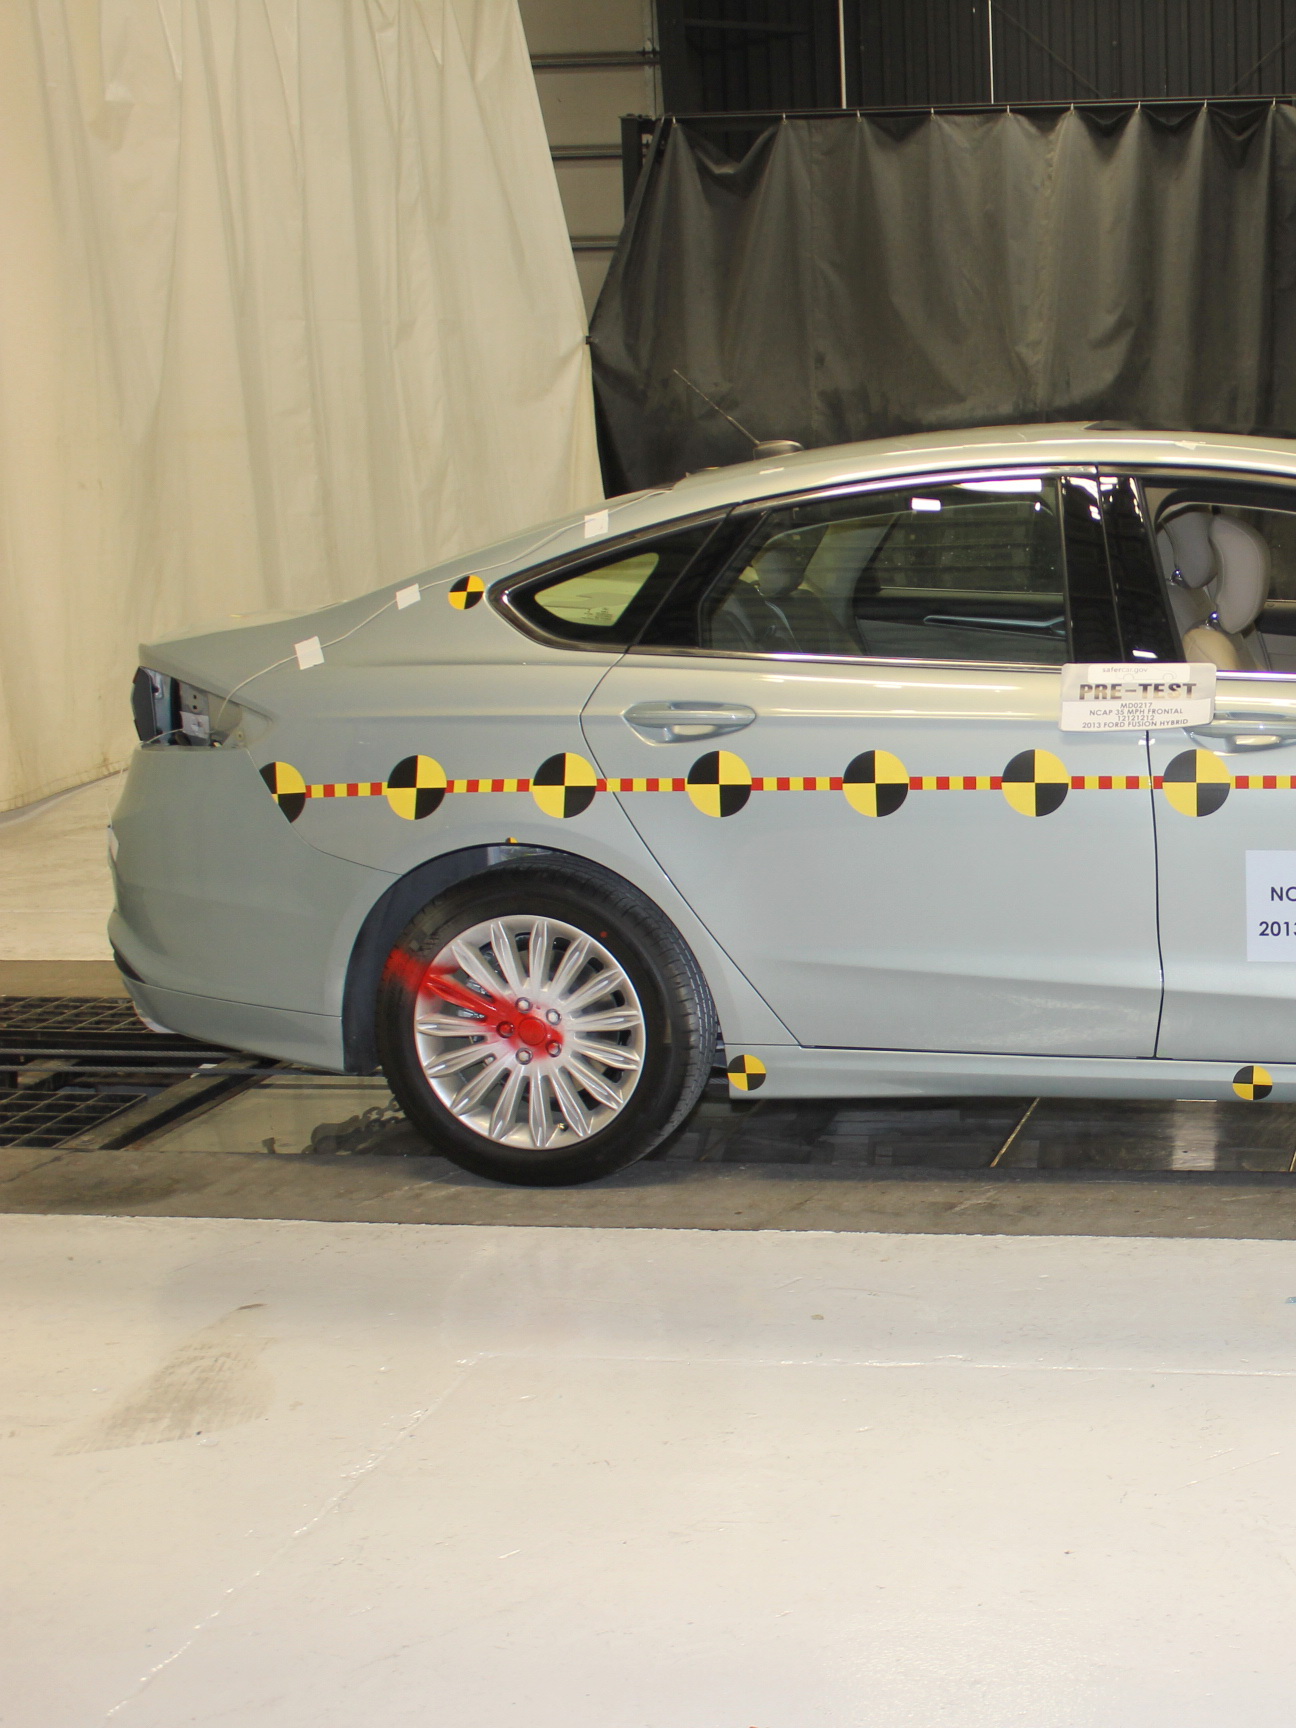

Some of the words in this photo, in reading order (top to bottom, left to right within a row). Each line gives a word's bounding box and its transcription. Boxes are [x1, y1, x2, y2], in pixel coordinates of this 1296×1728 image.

[1079, 683, 1197, 700] PRE-TEST
[1128, 720, 1157, 728] FUSION
[1159, 718, 1189, 727] HYBRID
